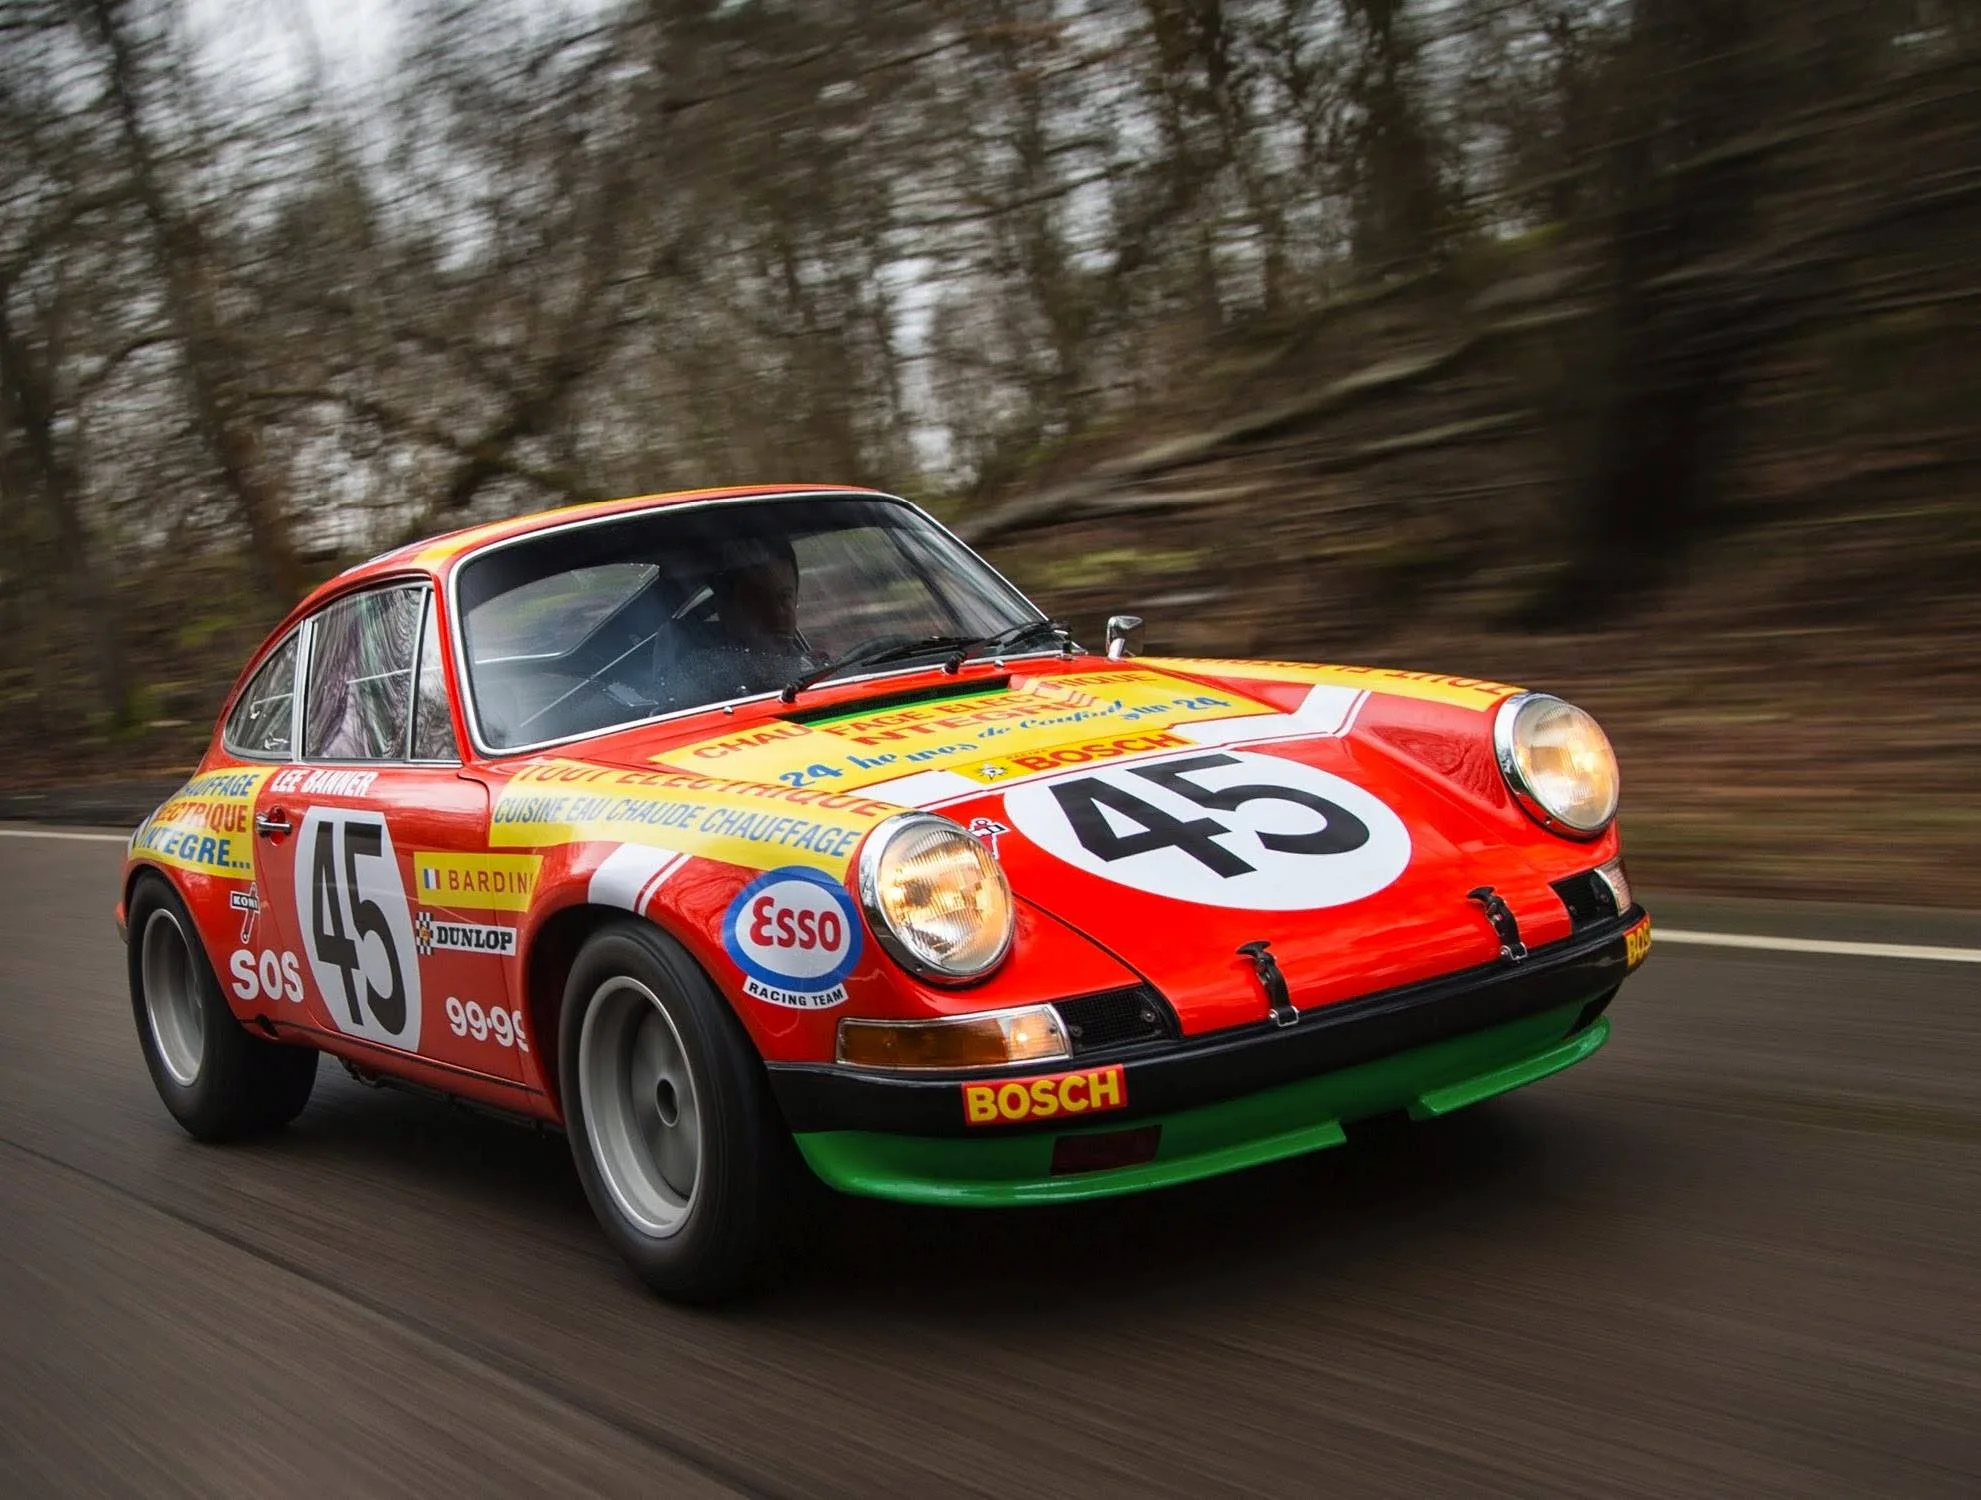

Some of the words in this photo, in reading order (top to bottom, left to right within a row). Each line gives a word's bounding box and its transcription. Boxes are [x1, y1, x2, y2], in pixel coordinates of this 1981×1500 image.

[779, 763, 844, 787] 24
[1171, 696, 1231, 711] 24
[1012, 733, 1190, 771] BOSCH
[270, 769, 310, 793] LEE
[300, 769, 379, 797] BANNER
[518, 764, 611, 783] TOUT
[615, 771, 891, 817] ELECTRIQUE
[155, 801, 249, 834] ECTRIQUE
[493, 796, 566, 824] CUISINE
[563, 796, 606, 821] EAU
[605, 799, 700, 830] CHAUDE
[700, 808, 863, 858] CHAUFFAGE
[1049, 752, 1370, 878] 45
[232, 893, 258, 910] KONI
[313, 820, 408, 1036] 45
[436, 924, 513, 951] DUNLOP
[230, 948, 305, 1003] SOS
[748, 981, 807, 1006] RACING
[811, 988, 844, 1006] TEAM
[966, 1069, 1121, 1123] BOSCH
